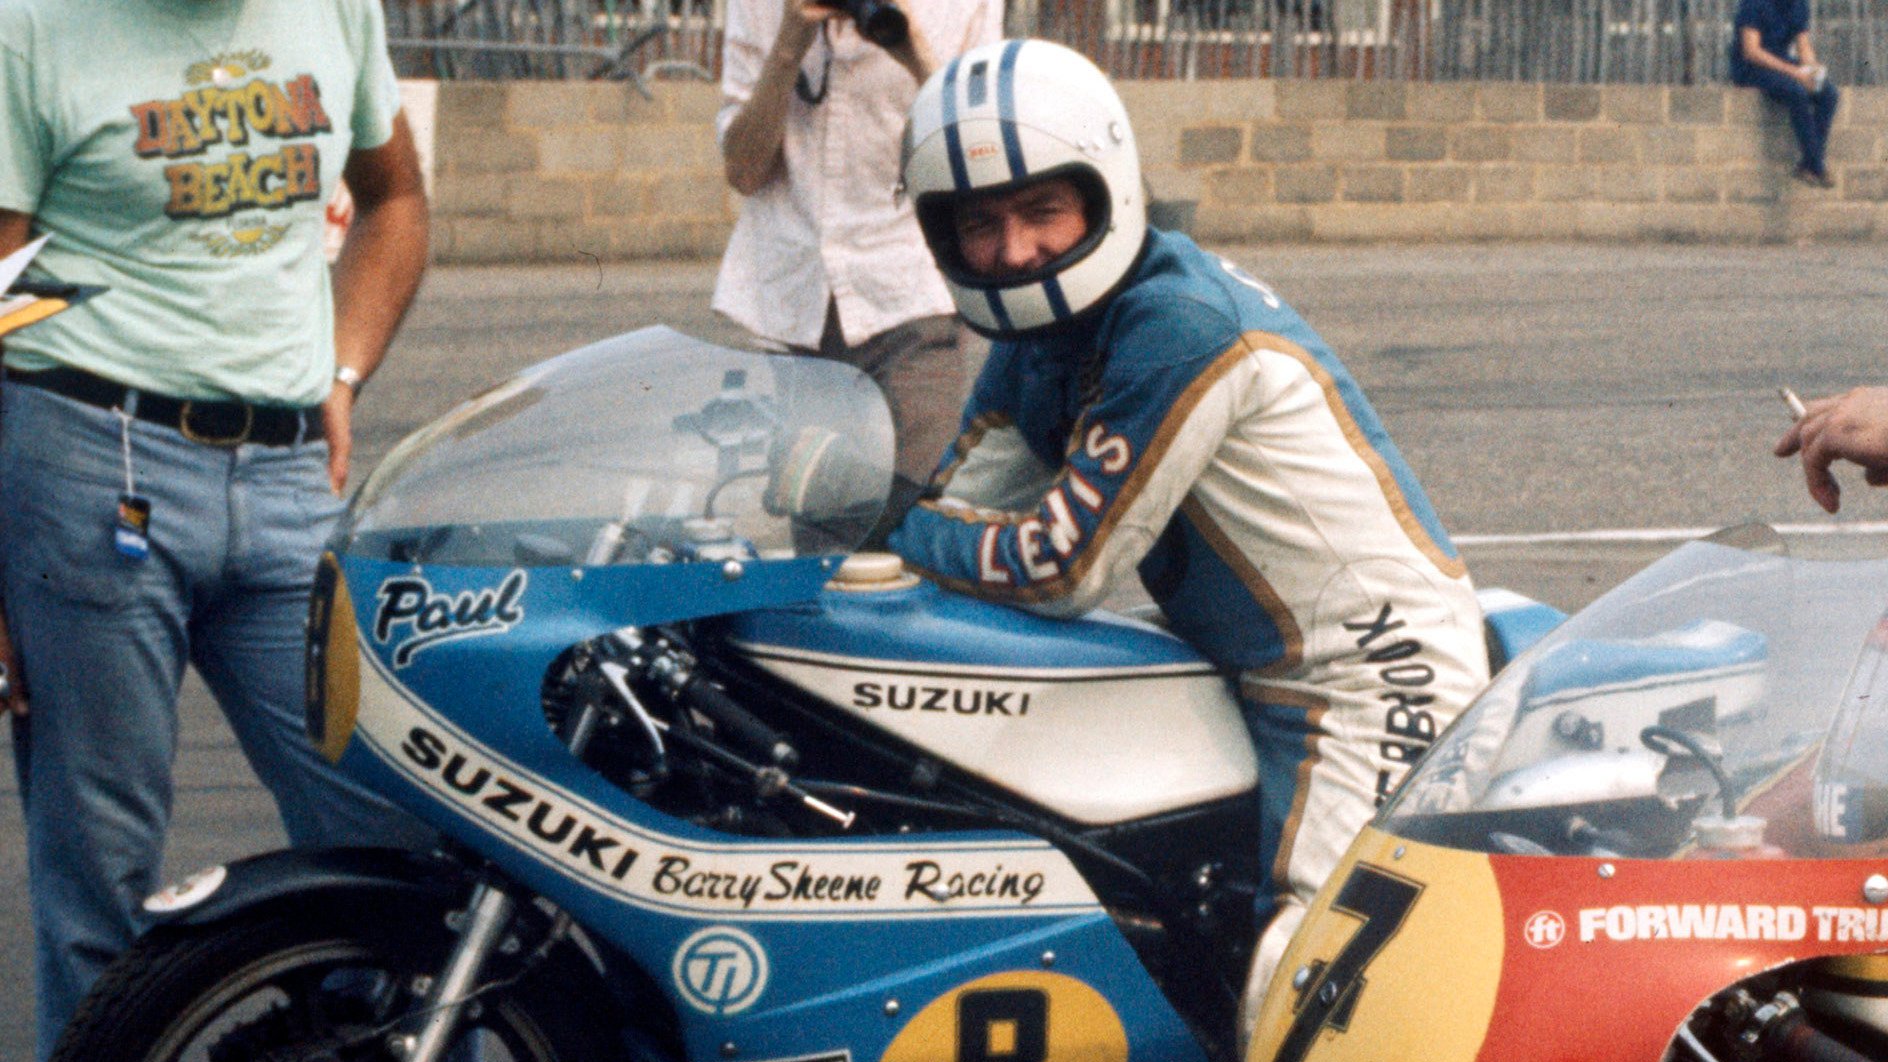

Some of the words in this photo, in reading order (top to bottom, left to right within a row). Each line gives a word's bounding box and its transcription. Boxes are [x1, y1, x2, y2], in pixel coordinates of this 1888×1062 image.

[130, 74, 332, 158] DAYTONA
[164, 143, 321, 220] BEACH
[979, 423, 1132, 588] LEWIS
[375, 569, 528, 645] Paul
[852, 682, 1031, 716] SUZUKI
[401, 726, 640, 880] SUZUKI
[651, 855, 762, 907] Barry
[763, 861, 882, 902] Sheene
[904, 860, 1045, 904] Racing
[1579, 904, 1806, 943] FORWARD
